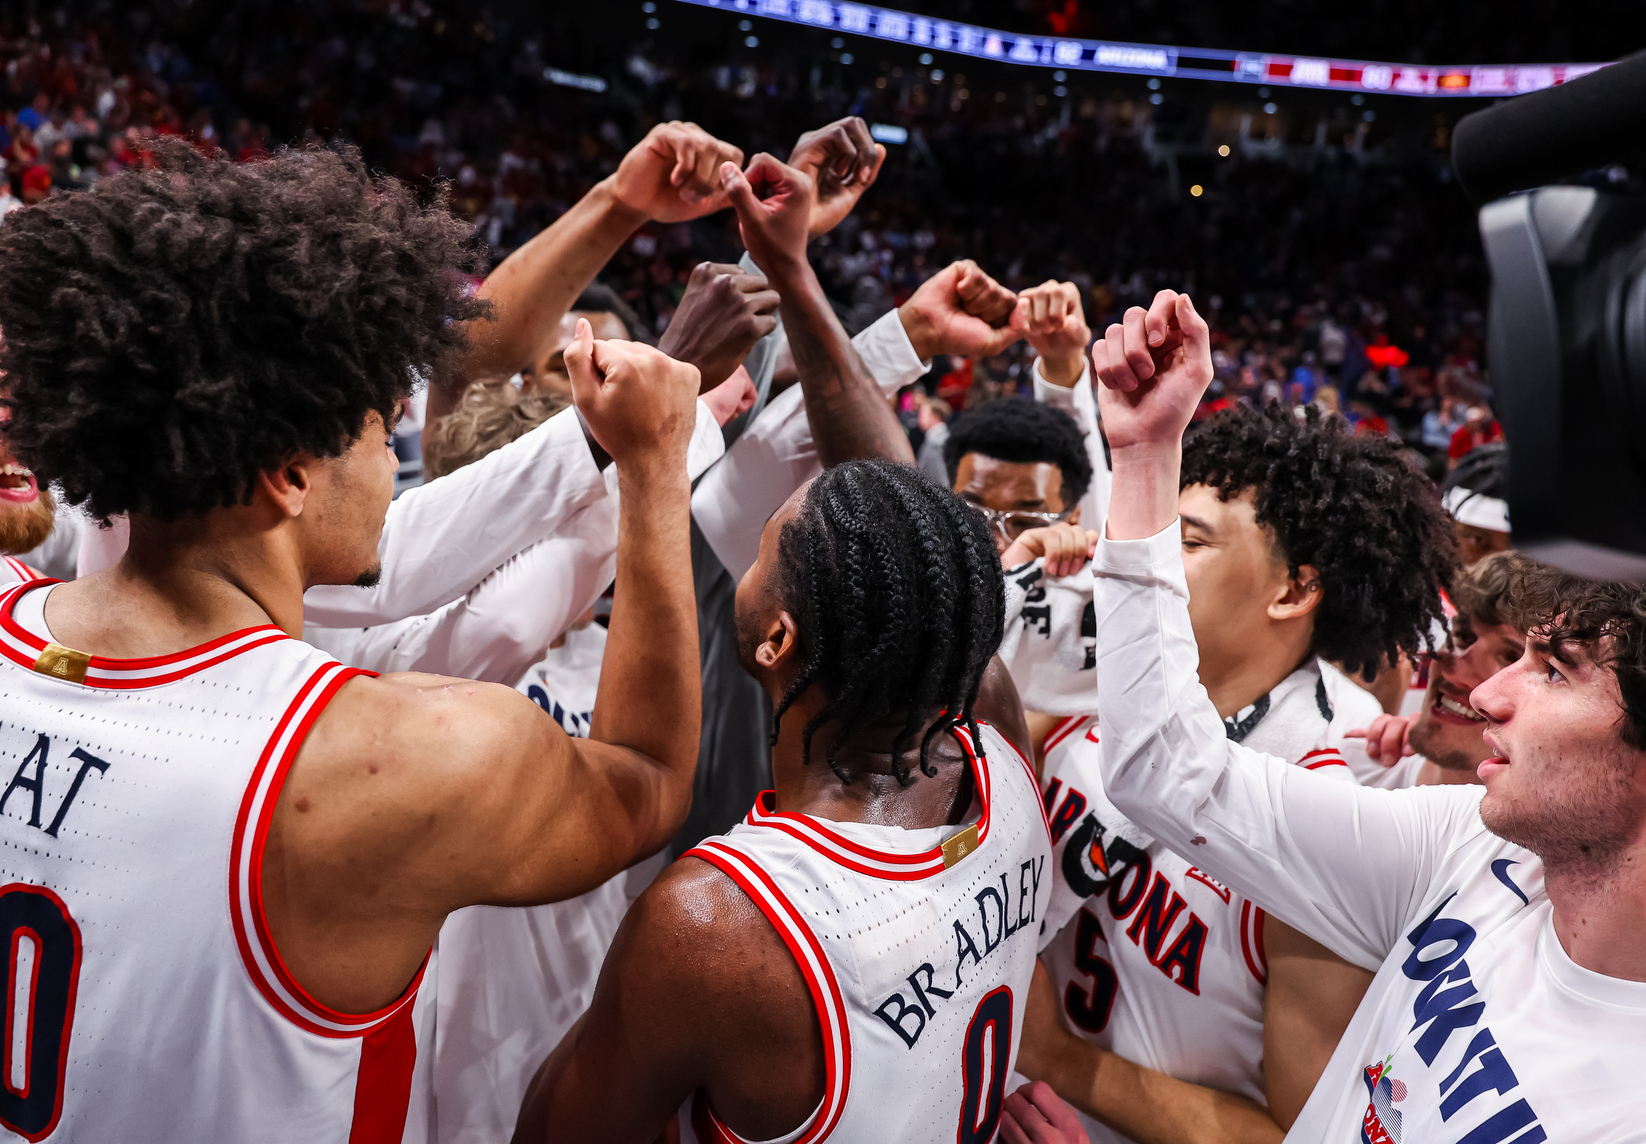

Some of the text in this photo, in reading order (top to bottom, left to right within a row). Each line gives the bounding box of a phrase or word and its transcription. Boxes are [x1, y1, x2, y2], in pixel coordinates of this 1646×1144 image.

[51, 656, 69, 676] A
[0, 732, 111, 838] AT
[873, 855, 1045, 1049] BRADLEY
[1044, 776, 1208, 996] RONA
[1065, 908, 1118, 1033] 5
[958, 984, 1013, 1144] 0
